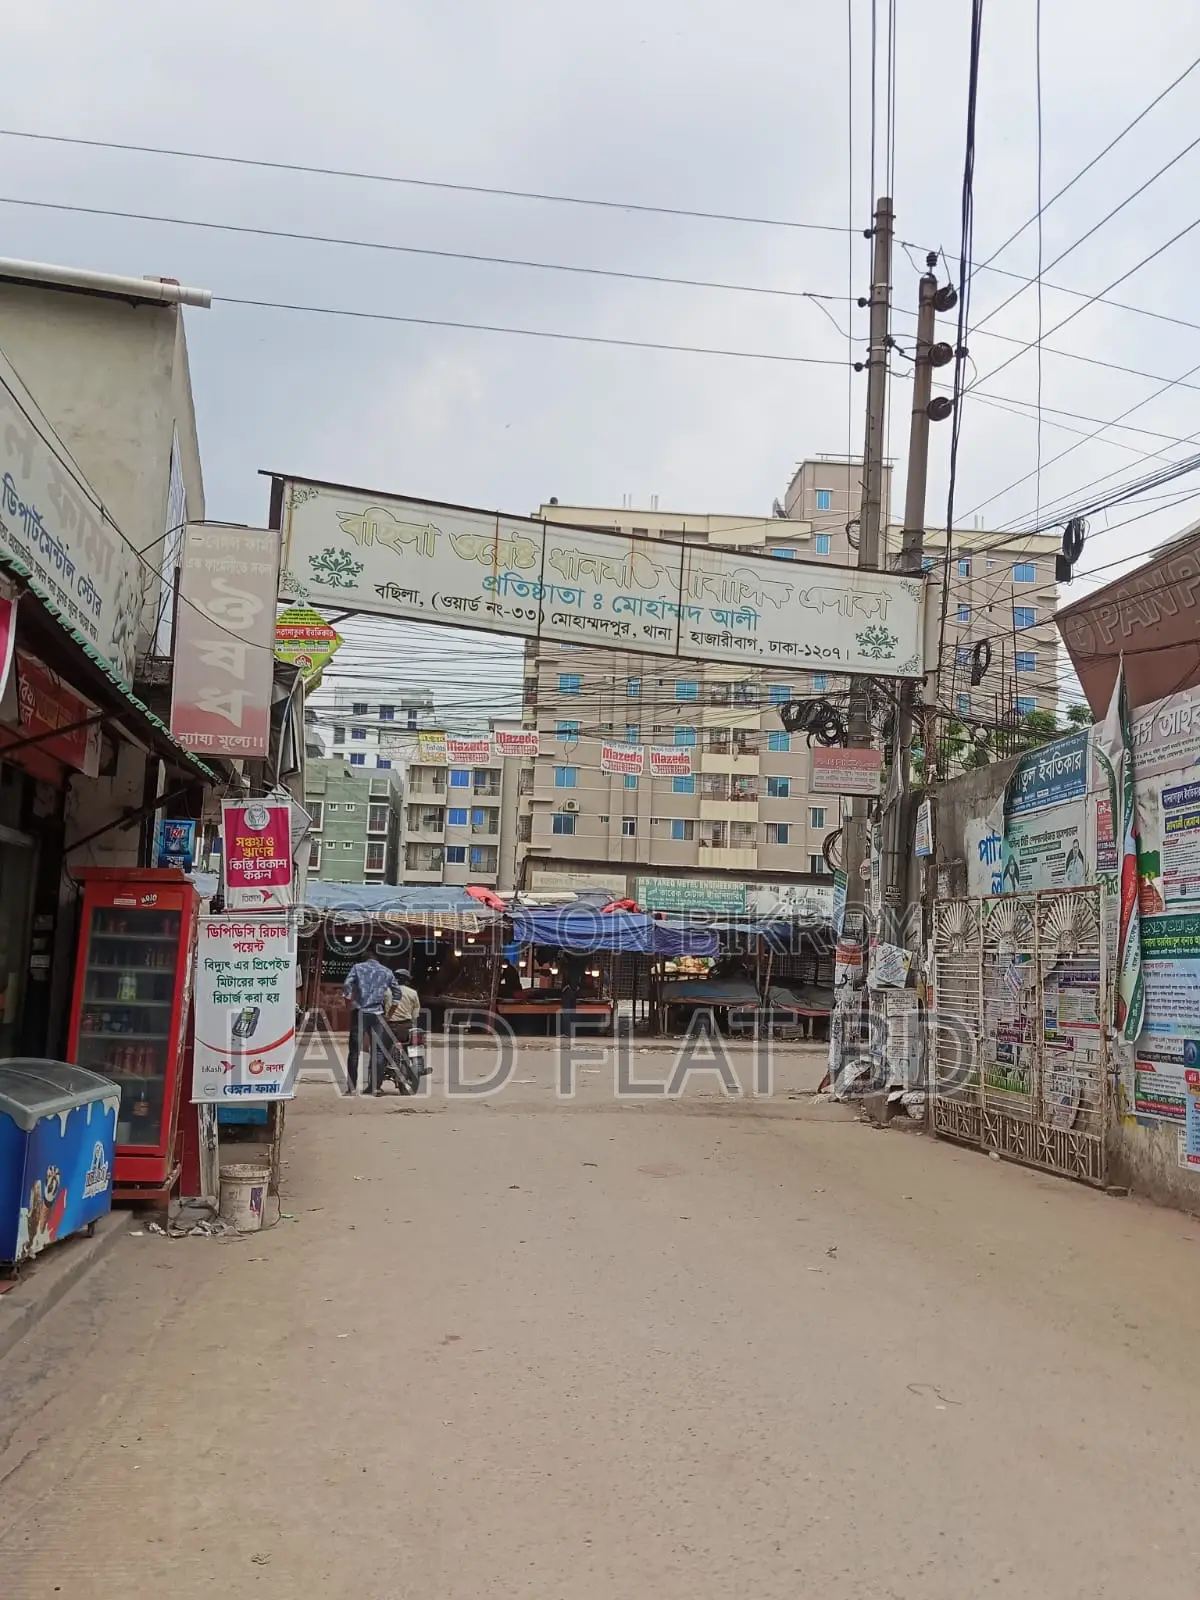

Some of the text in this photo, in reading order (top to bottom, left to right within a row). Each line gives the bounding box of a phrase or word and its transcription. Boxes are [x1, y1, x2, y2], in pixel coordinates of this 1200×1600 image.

[482, 571, 586, 609] প্রতিষ্ঠাতা
[709, 605, 762, 632] আলী
[374, 582, 424, 608] বছিলা,
[551, 612, 637, 639] মোহাম্মদপুর,
[643, 624, 673, 641] থানা
[689, 631, 764, 655] হাজারীবাগ,
[235, 836, 274, 848] সঞ্চয় ও
[242, 846, 275, 858] ঋণের
[229, 857, 288, 871] কিস্তি বিকাশ
[243, 869, 272, 881] করুন
[205, 923, 256, 939] ডিপিডিসি
[232, 938, 266, 953] পয়েন্ট
[204, 956, 292, 973] বিদ্যুৎ এর প্রিপেইড
[216, 972, 279, 988] মিটারের কার্ড
[212, 989, 281, 1004] রিচার্জ করা হয়
